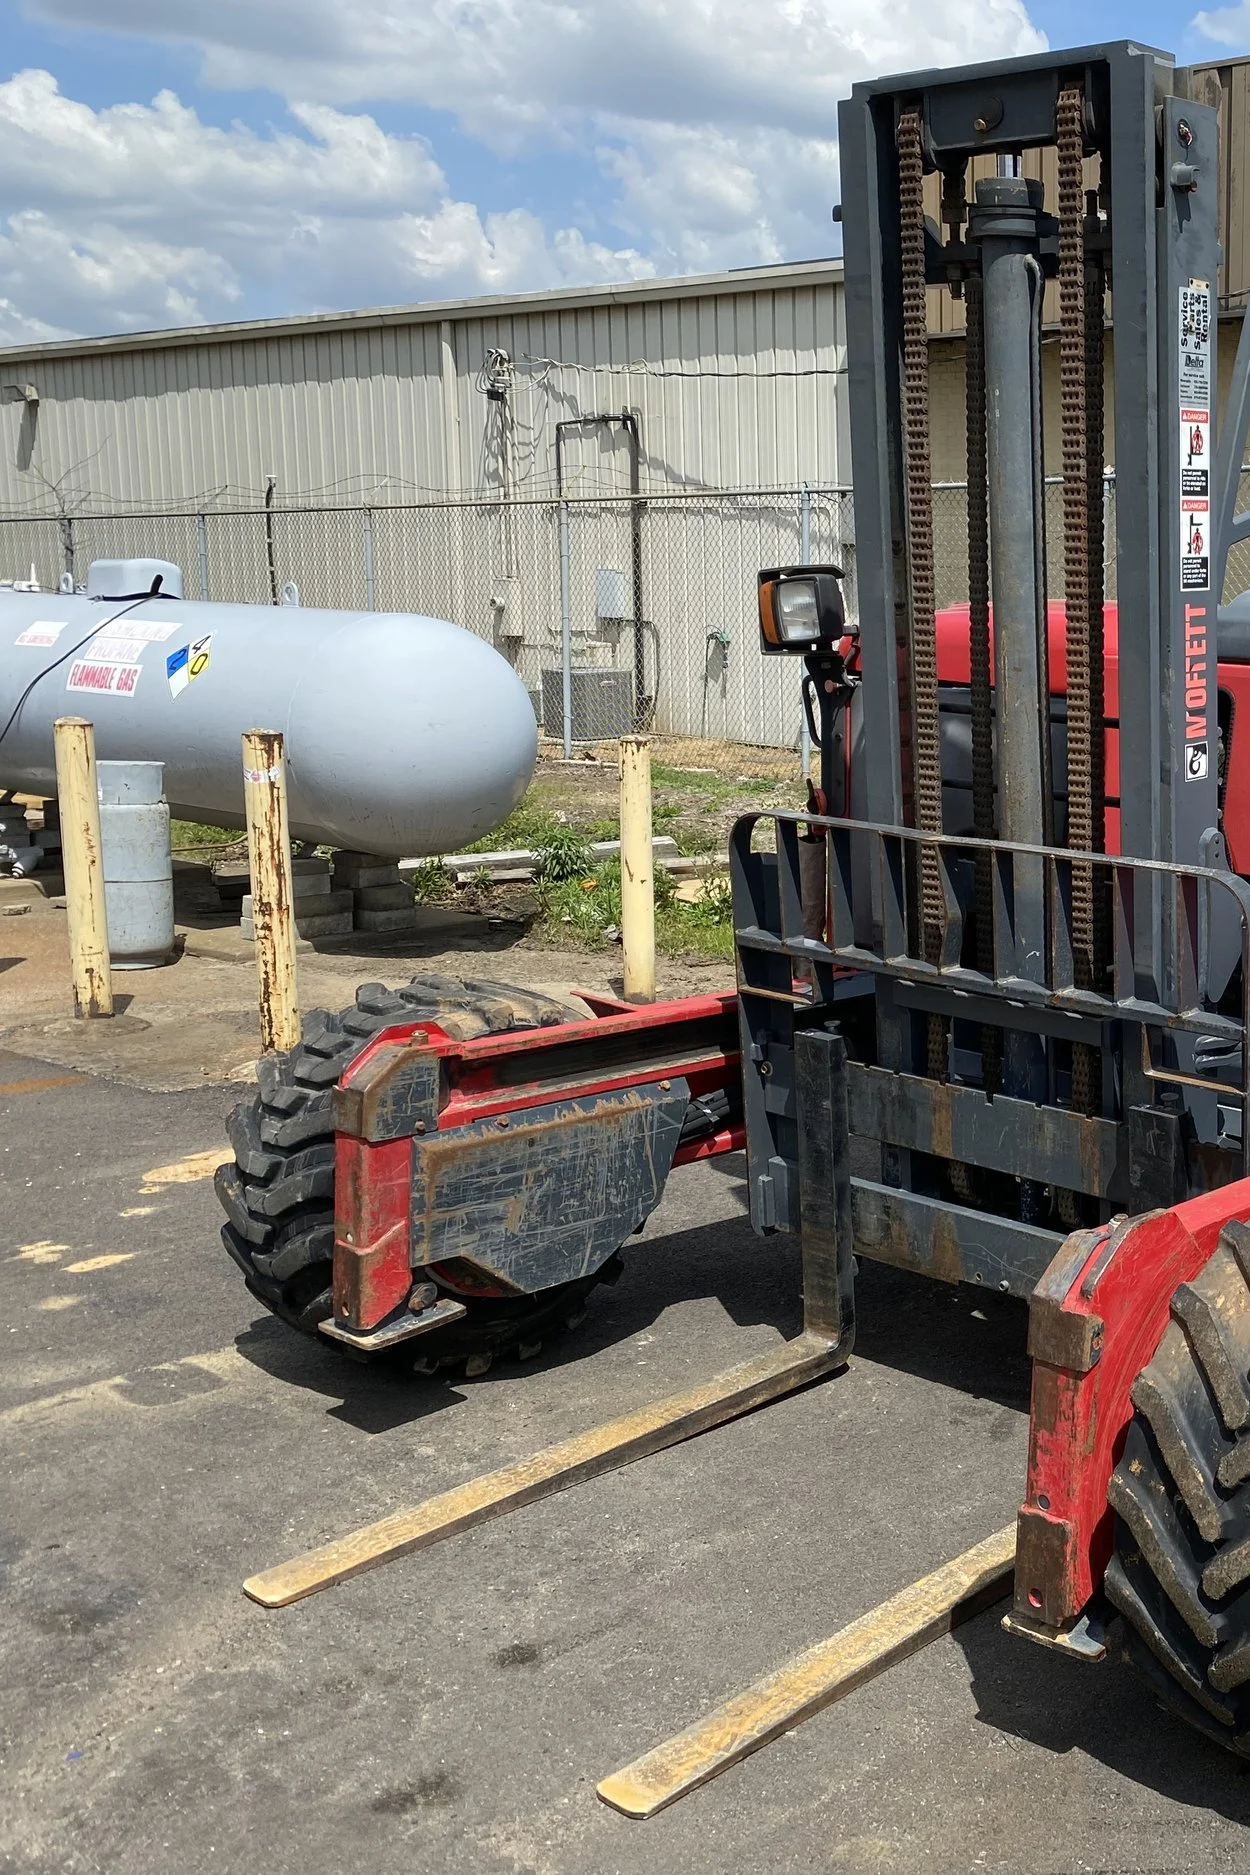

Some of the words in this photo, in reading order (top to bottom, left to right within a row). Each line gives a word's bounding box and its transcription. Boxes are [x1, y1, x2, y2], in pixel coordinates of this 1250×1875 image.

[1194, 293, 1202, 306] &
[1181, 292, 1189, 347] Service
[1194, 310, 1202, 350] Sales
[1185, 354, 1204, 368] Delta
[1187, 413, 1207, 421] DANGER
[192, 635, 212, 653] 4
[169, 648, 188, 671] 2
[191, 653, 209, 676] 0
[1185, 603, 1207, 739] MOFFETT
[69, 664, 116, 690] FLAMMABLE
[116, 668, 138, 692] GAS
